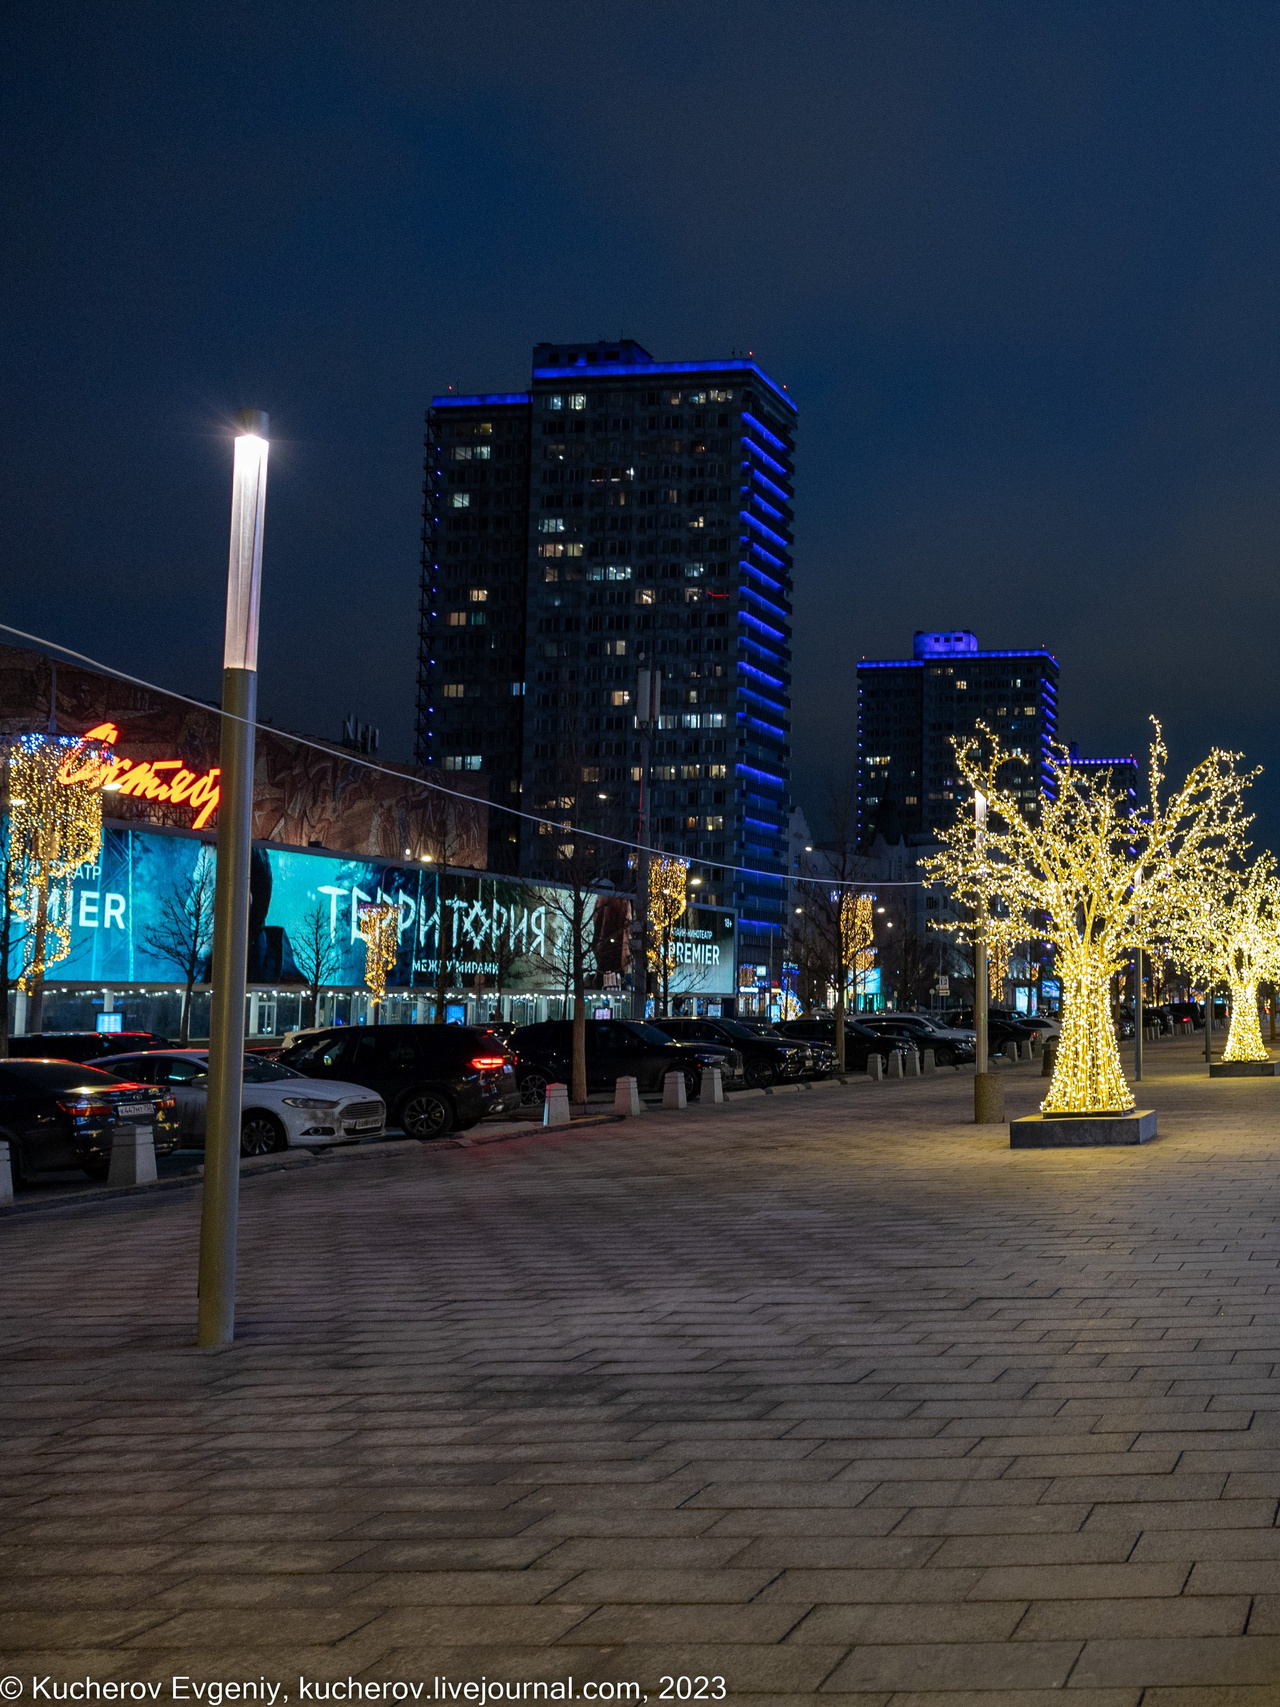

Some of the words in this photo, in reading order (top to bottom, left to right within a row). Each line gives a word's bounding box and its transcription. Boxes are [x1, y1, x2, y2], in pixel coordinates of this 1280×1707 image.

[317, 885, 546, 957] ТЕРРИТОРИЯ
[724, 917, 732, 928] 18+
[668, 941, 720, 965] PREMIER
[455, 961, 499, 975] МИРАМИ
